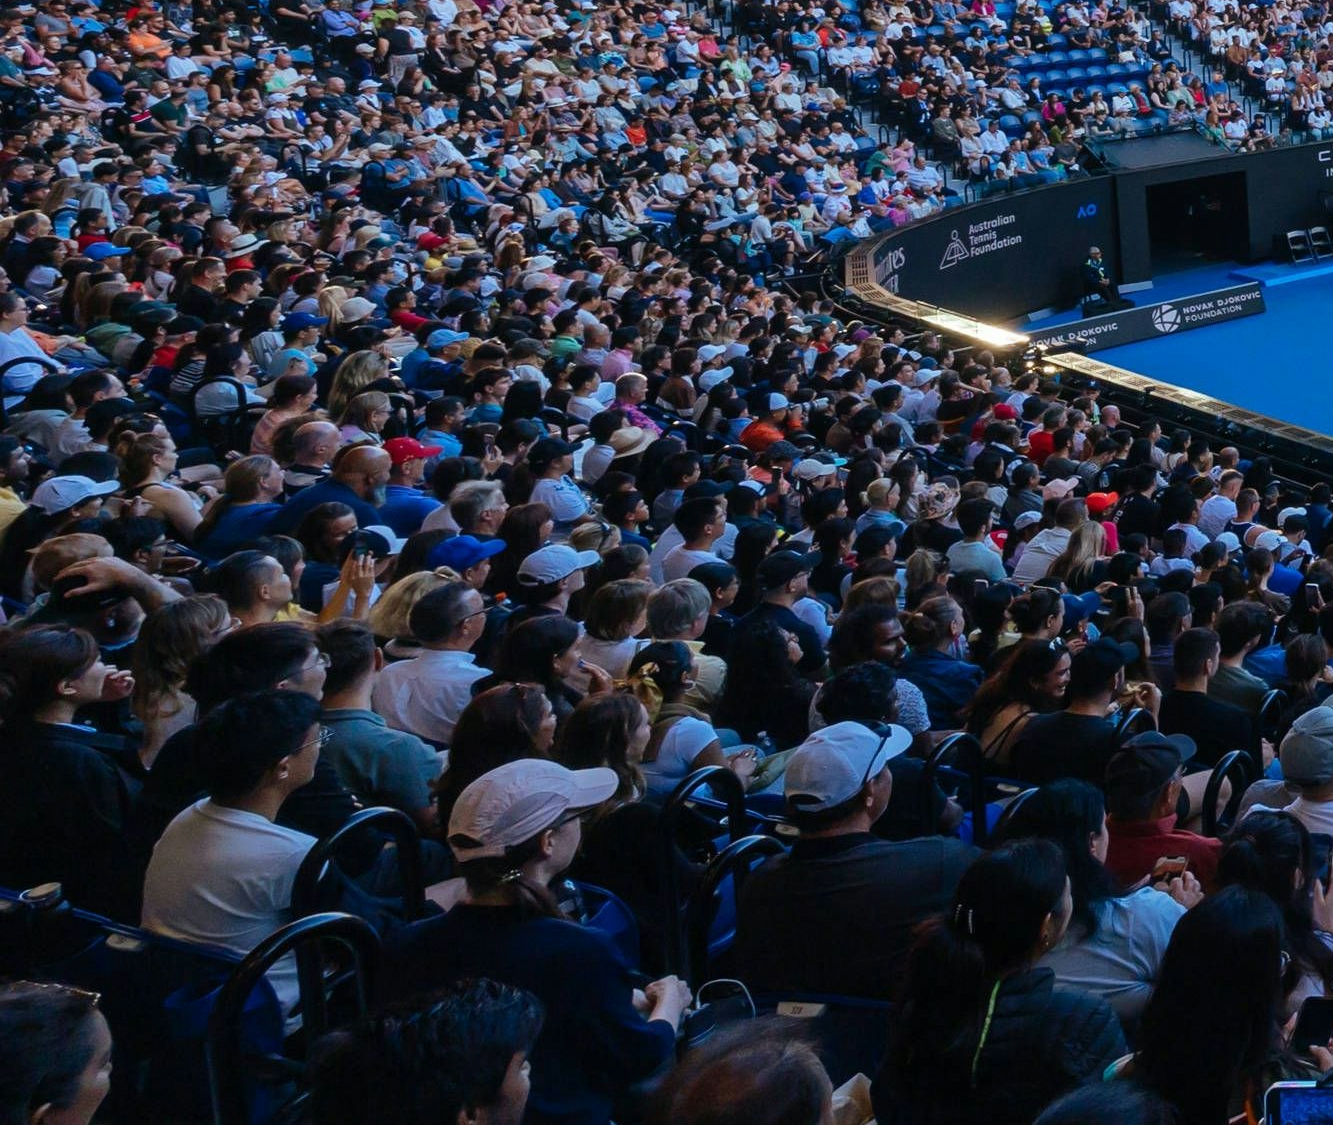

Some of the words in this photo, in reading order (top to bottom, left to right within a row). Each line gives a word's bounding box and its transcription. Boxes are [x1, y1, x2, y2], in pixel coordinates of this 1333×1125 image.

[1077, 203, 1097, 219] AO
[968, 214, 1016, 235] Australian
[969, 231, 998, 246] Tennis
[970, 234, 1022, 258] Foundation
[1183, 302, 1214, 315] NOVAK
[1216, 290, 1262, 308] DJOKOVIC
[1185, 304, 1243, 323] FOUNDATION
[1068, 322, 1119, 341] DJOKOVIC
